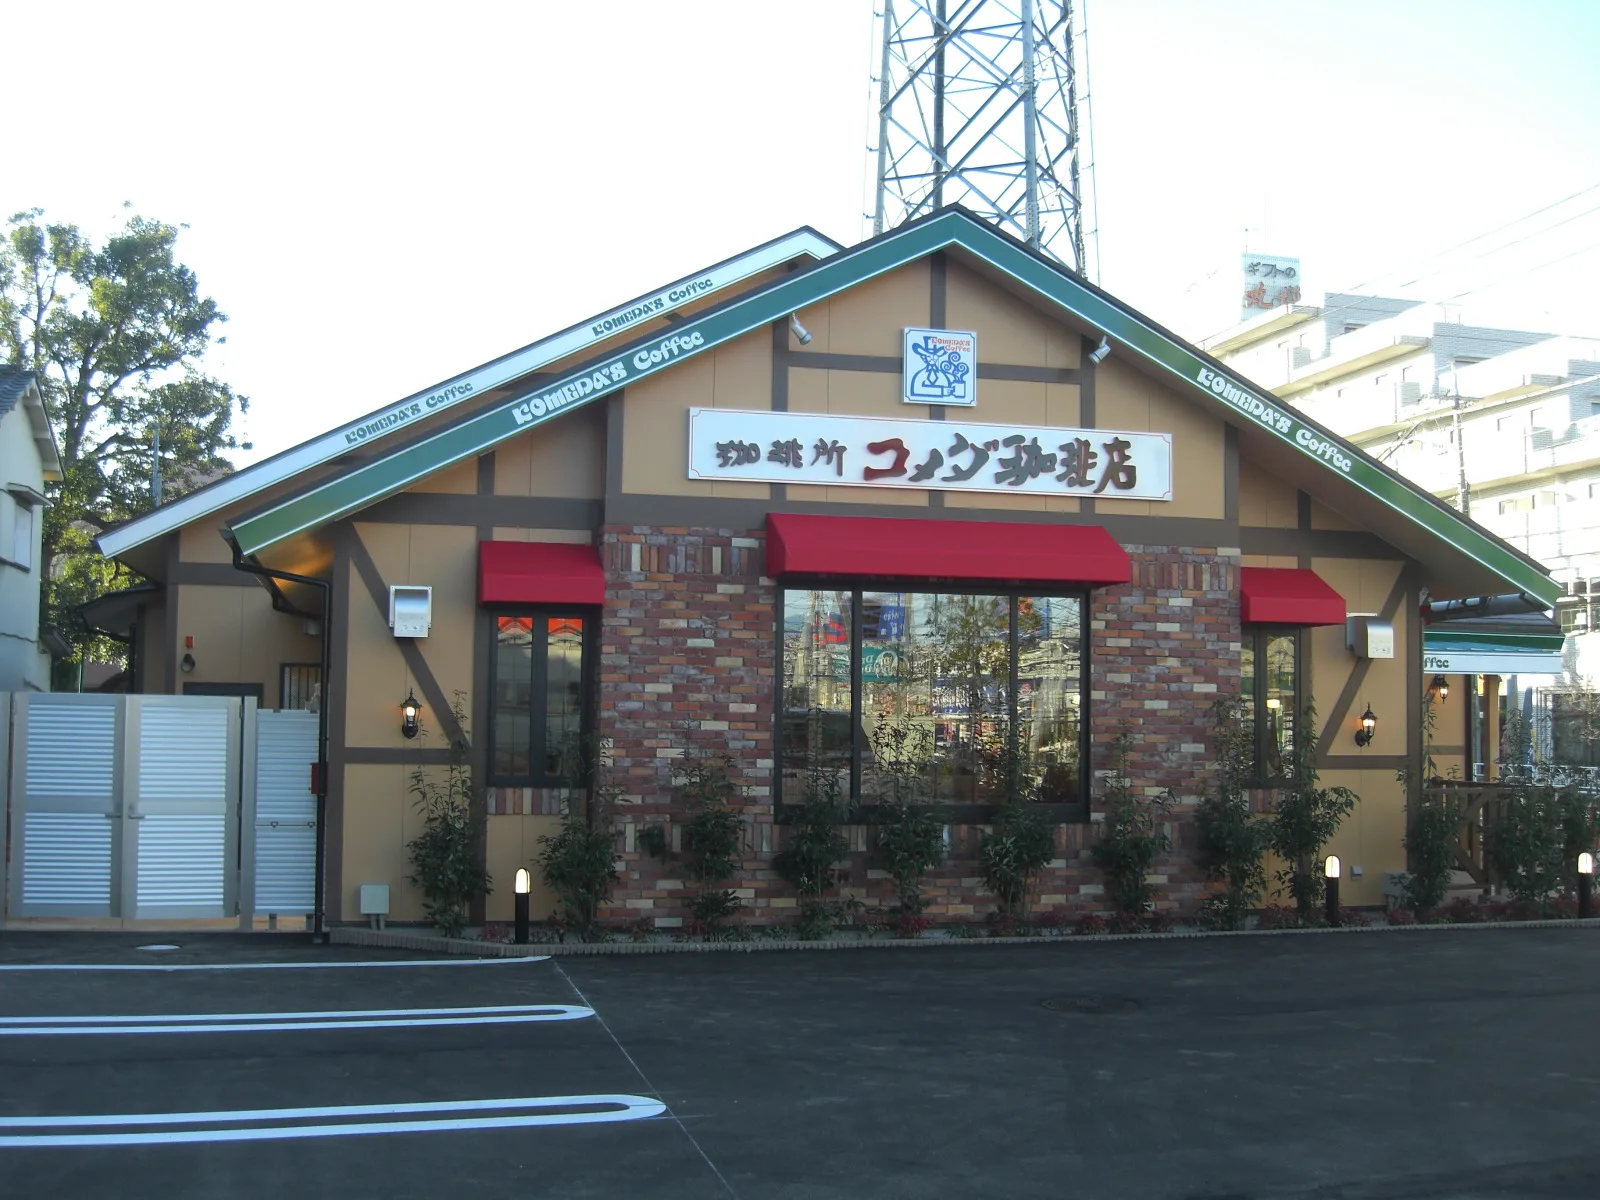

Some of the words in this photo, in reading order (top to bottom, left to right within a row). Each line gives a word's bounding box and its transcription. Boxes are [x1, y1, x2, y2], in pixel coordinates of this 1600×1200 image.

[592, 297, 663, 337] KOMEDA'S
[669, 278, 713, 303] Coffee
[512, 361, 627, 425] KOMEDA'S
[633, 331, 705, 371] Coffee
[345, 403, 420, 445] KOMEDA'S
[426, 382, 473, 408] Coffee
[1196, 368, 1292, 434] KOMEDA'S
[1296, 429, 1352, 472] Coffee
[716, 438, 847, 477] 珈琲所
[863, 433, 1137, 493] コメダ珈琲店
[1424, 657, 1449, 668] ffee
